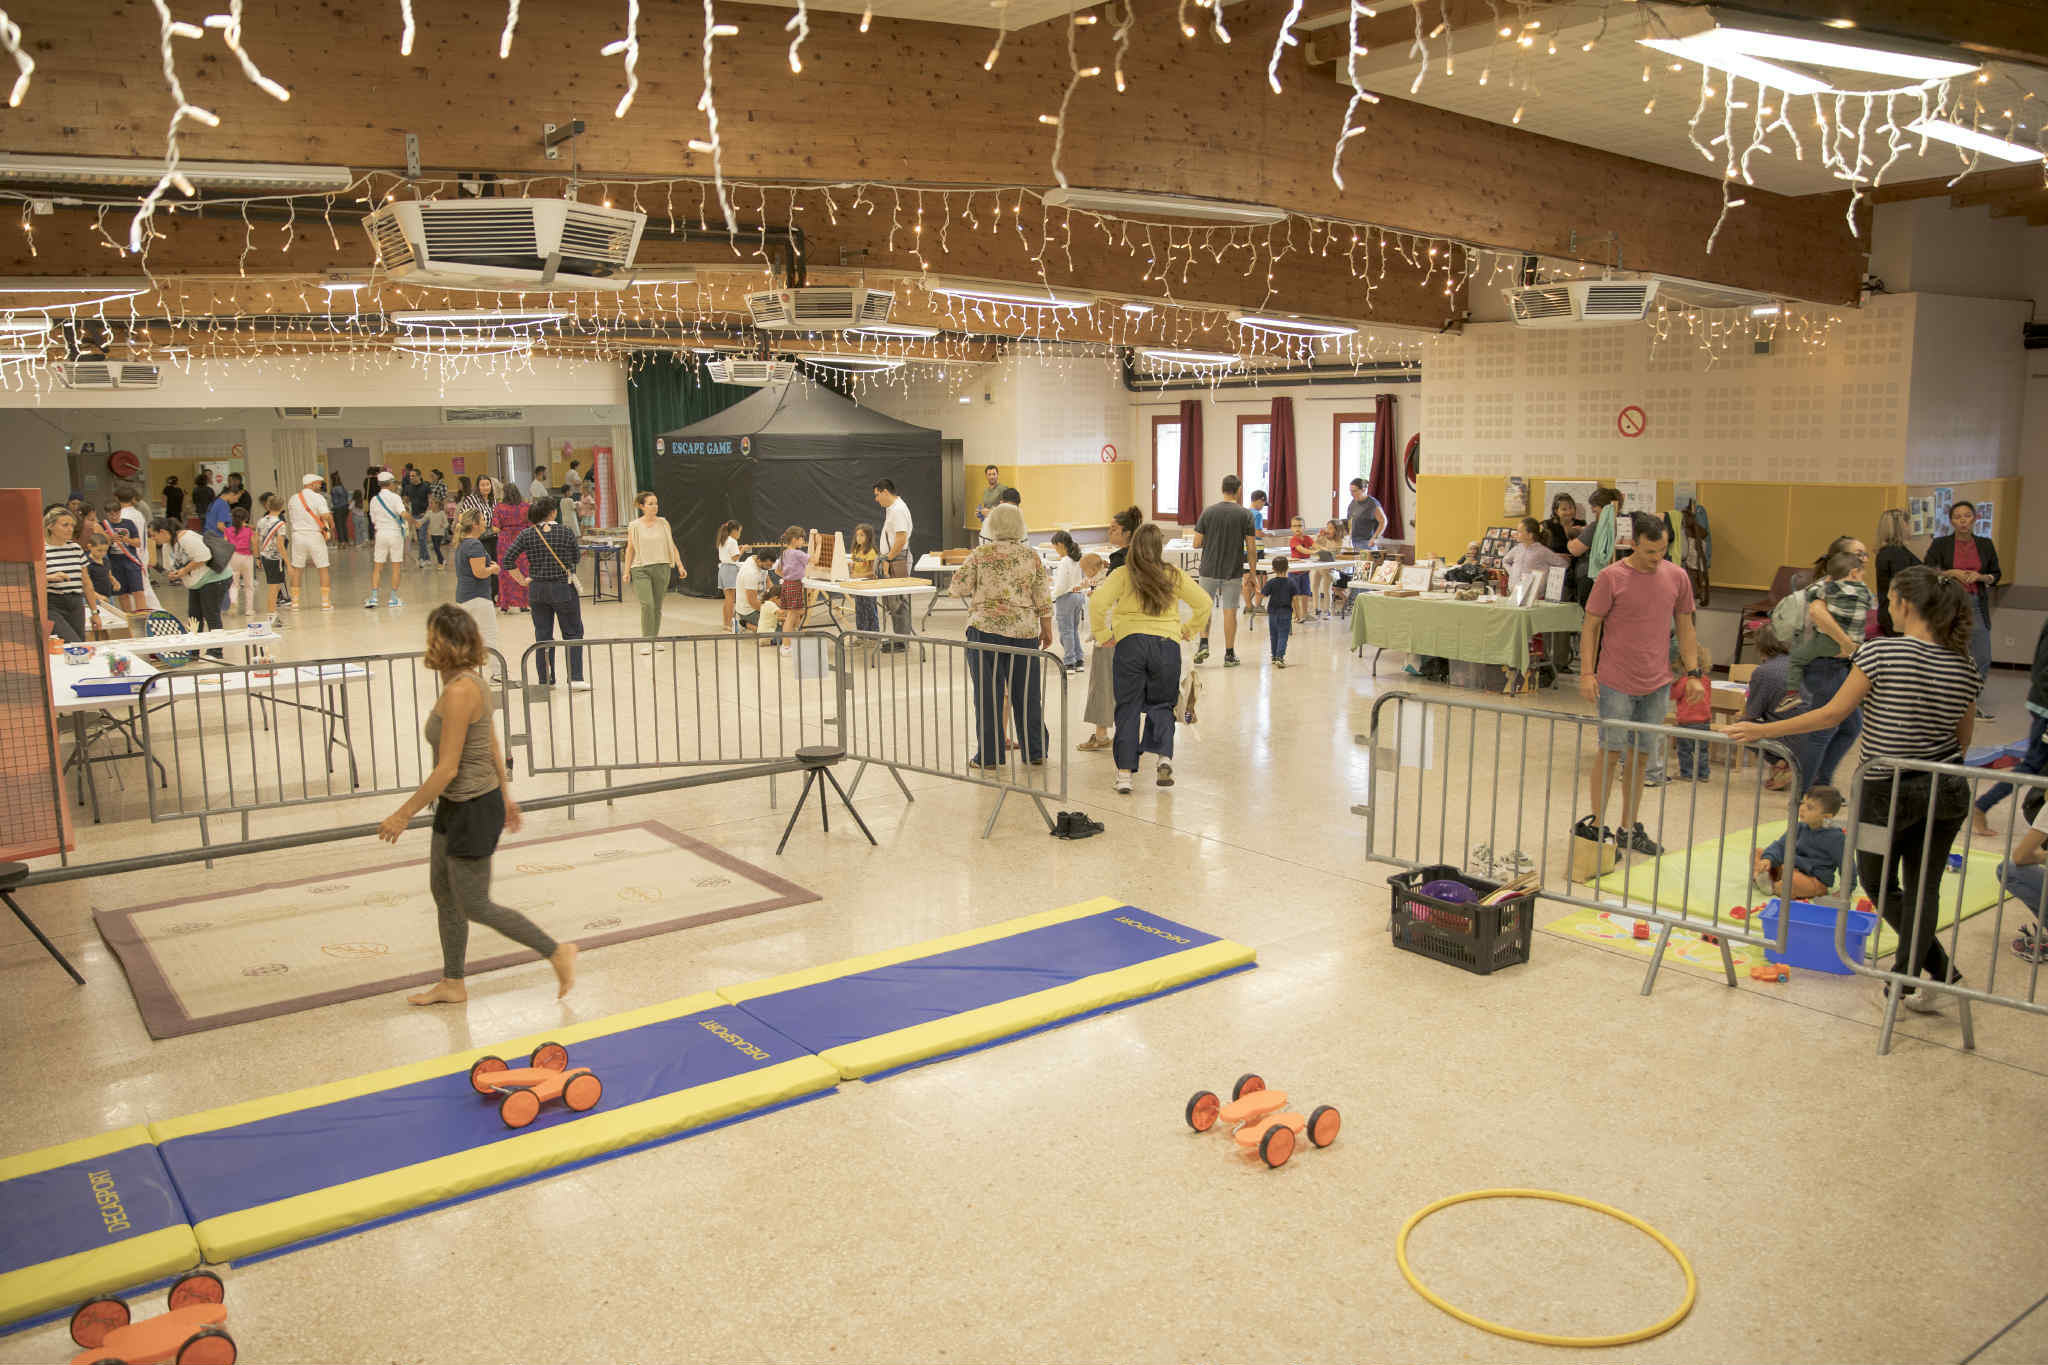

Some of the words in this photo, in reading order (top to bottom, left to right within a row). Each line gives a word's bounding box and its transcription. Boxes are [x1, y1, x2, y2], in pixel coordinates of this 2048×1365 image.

[672, 441, 704, 455] ESCAPE
[706, 441, 733, 455] GAME
[1113, 916, 1191, 944] DECASPORT
[698, 1020, 771, 1061] DECASPORT
[88, 1169, 131, 1233] DECASPORT
